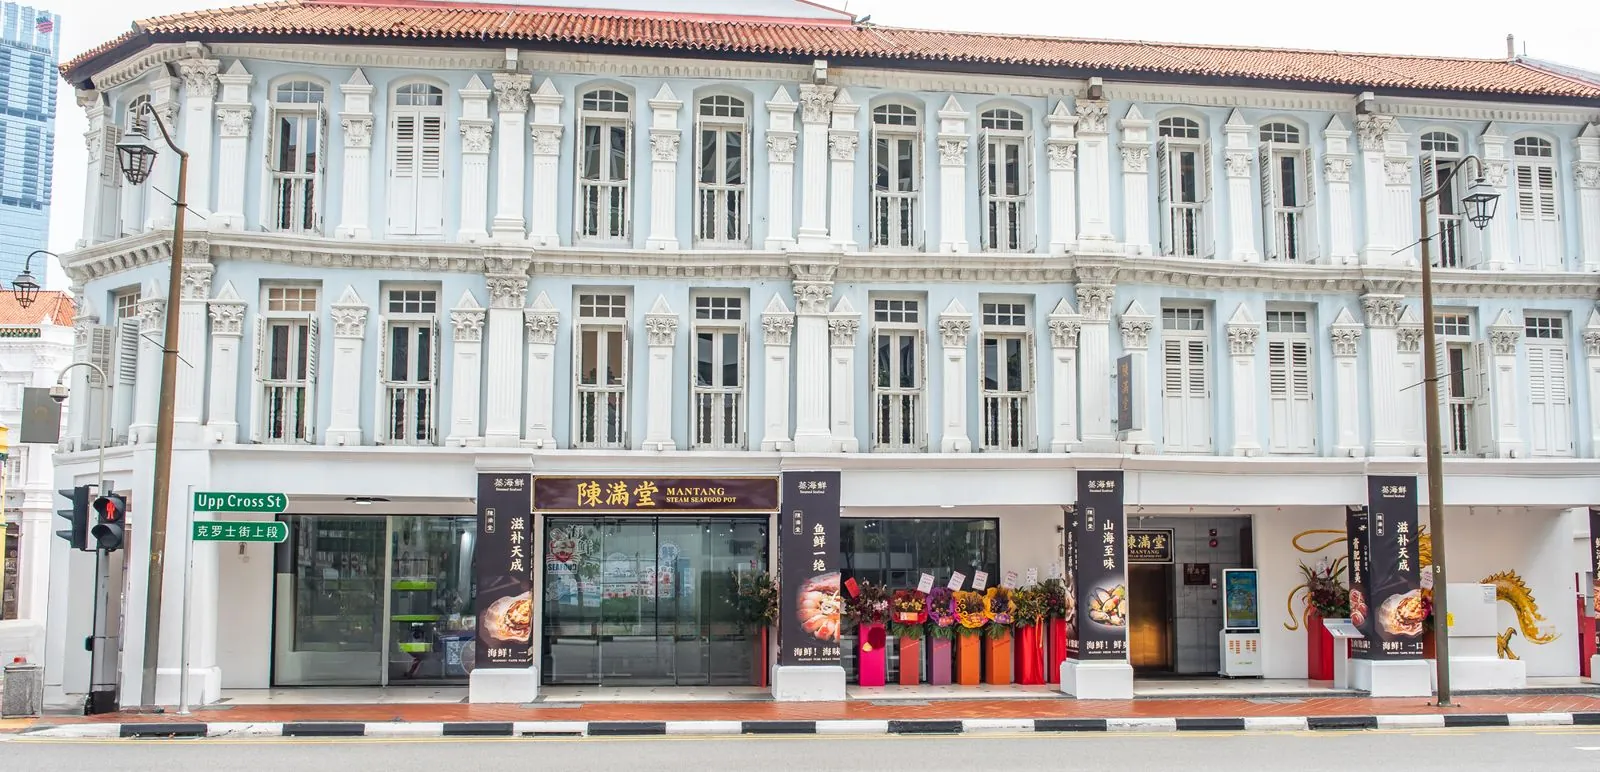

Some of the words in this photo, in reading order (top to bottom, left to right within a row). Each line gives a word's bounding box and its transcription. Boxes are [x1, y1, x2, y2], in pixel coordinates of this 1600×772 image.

[198, 494, 224, 510] Upp
[227, 494, 264, 507] Cross
[266, 495, 281, 508] St
[666, 487, 725, 496] MANTANG
[197, 525, 278, 538] 克罗士街上段
[510, 517, 524, 572] 滋补天成
[813, 523, 826, 572] 鱼鲜一绝
[1103, 519, 1115, 570] 山海至味
[1397, 521, 1410, 572] 滋补天成
[1436, 565, 1441, 573] 3
